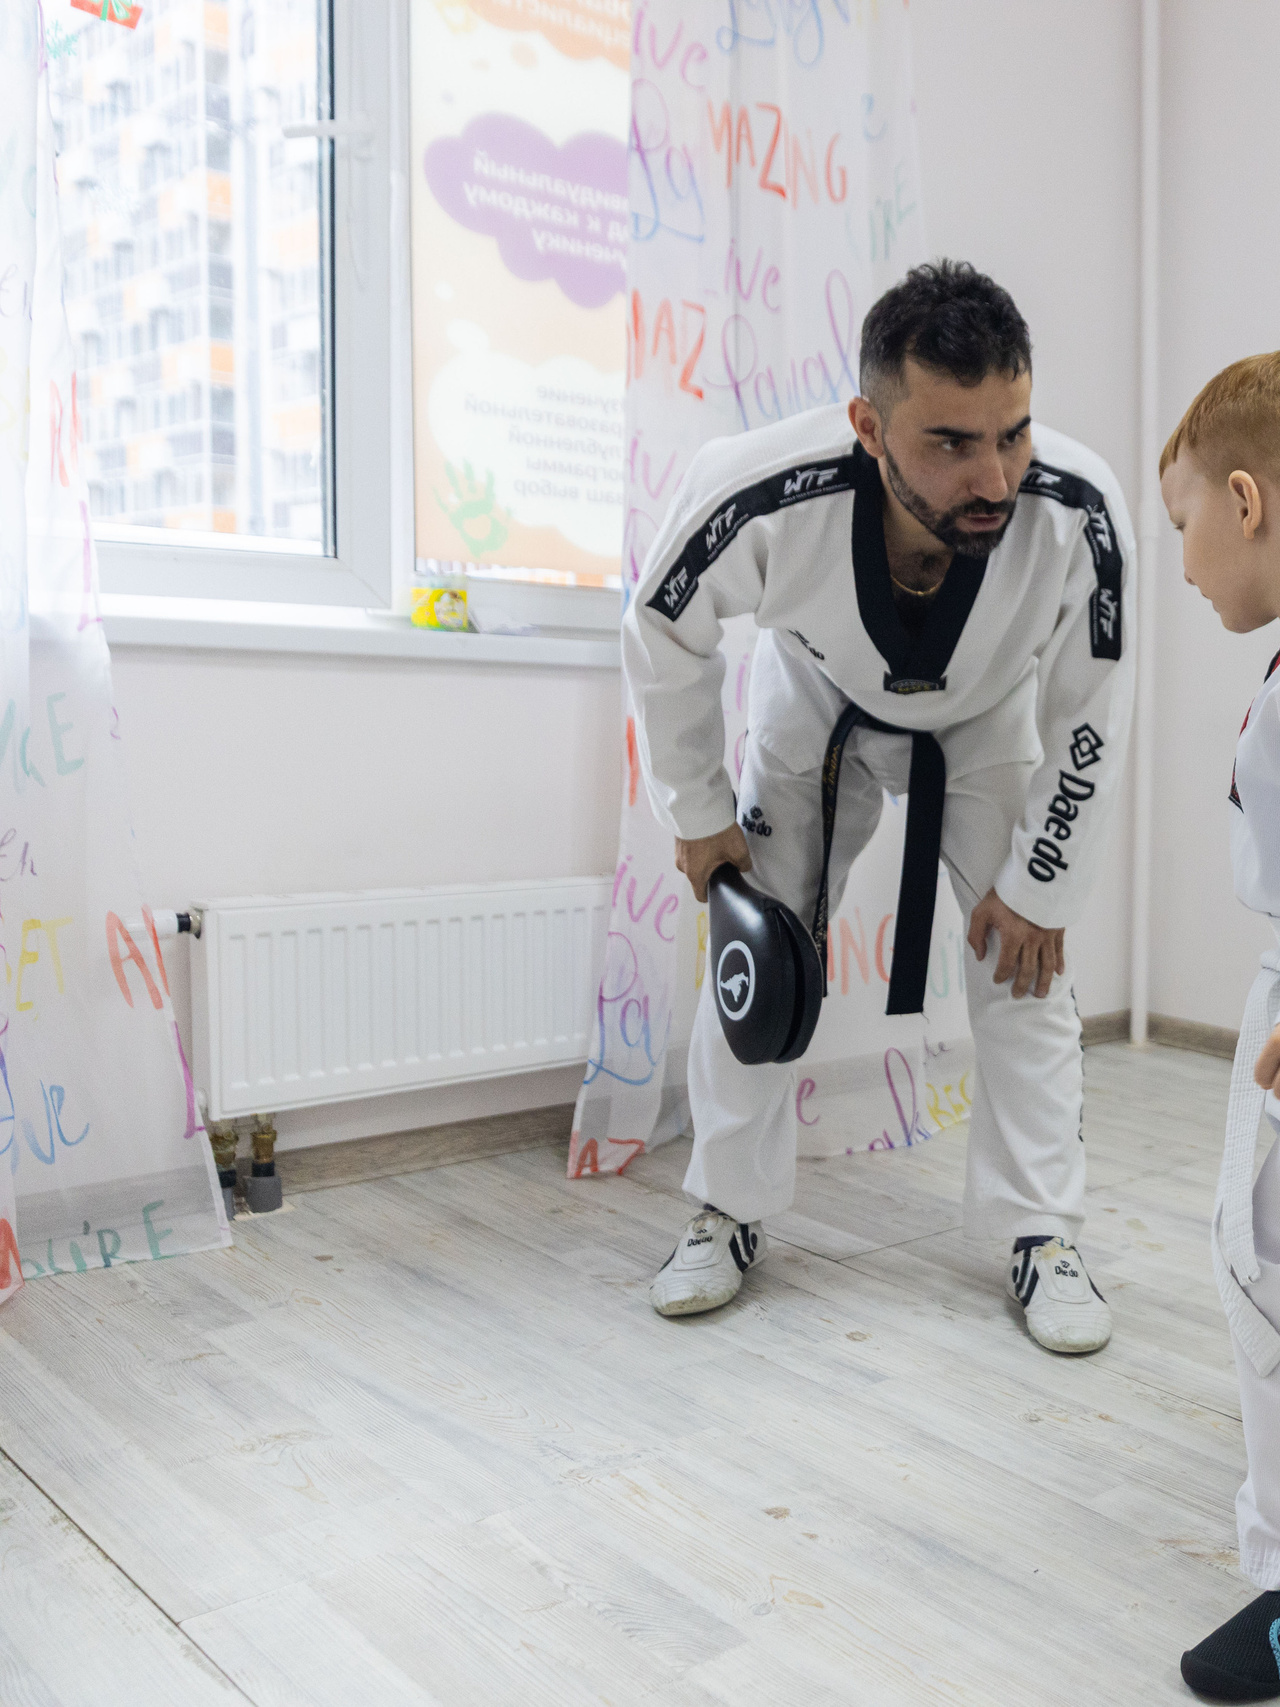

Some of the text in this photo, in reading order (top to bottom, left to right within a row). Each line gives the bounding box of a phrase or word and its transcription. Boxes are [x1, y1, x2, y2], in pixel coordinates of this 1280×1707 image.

[783, 467, 838, 496] WTF
[705, 502, 737, 551] WTF
[663, 565, 688, 610] WTF
